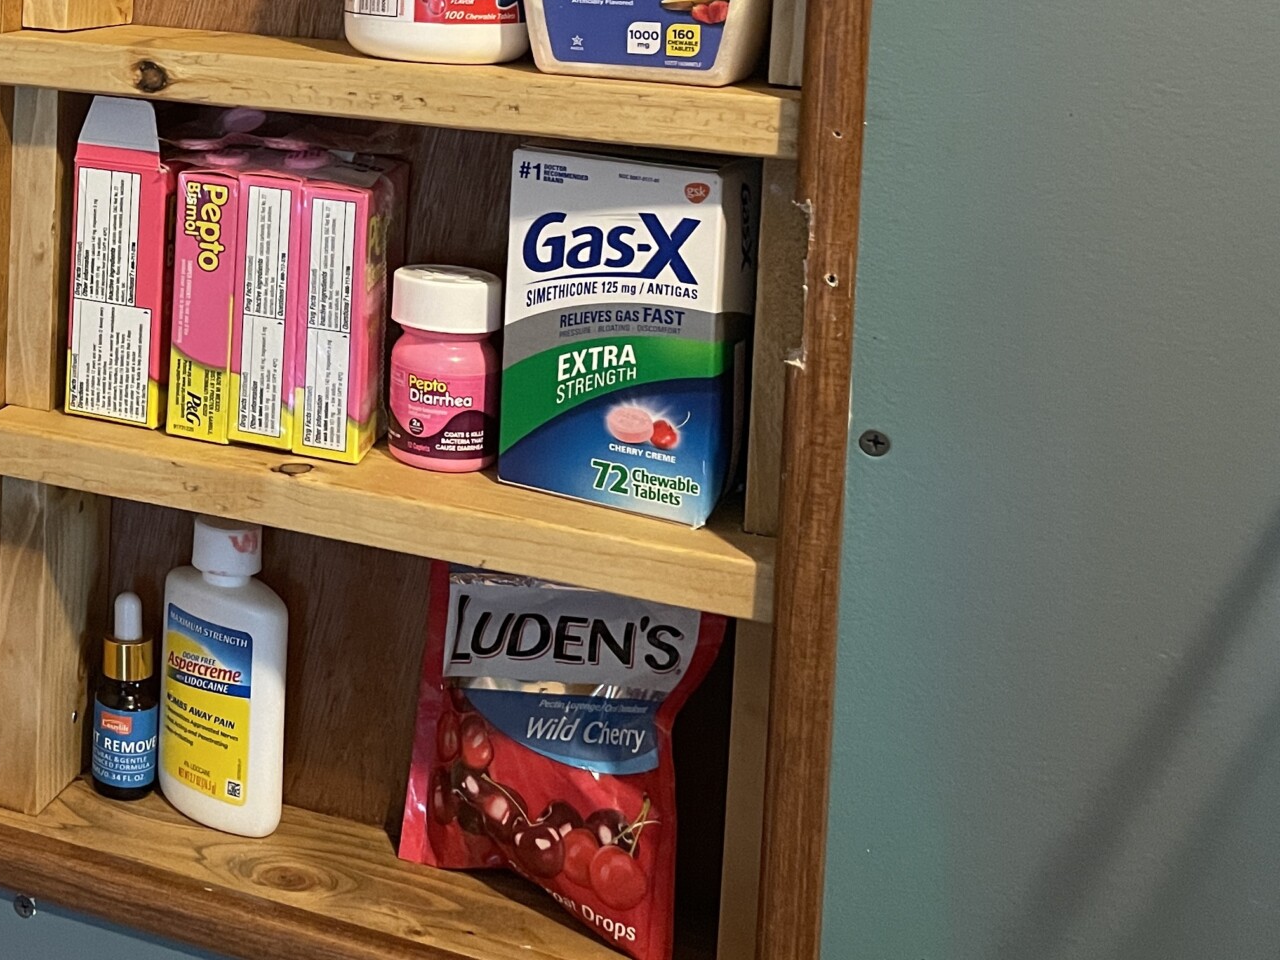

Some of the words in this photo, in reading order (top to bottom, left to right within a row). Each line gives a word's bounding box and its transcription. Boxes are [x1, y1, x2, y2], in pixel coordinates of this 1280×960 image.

[444, 11, 464, 20] 100
[629, 30, 659, 41] 1000
[672, 29, 694, 39] 160
[519, 161, 541, 180] #1
[544, 164, 567, 172] DOCTOR
[544, 171, 589, 181] RECOMMENDED
[543, 176, 564, 184] BRAND
[687, 186, 706, 199] gsk
[184, 181, 201, 236] Bismol
[197, 183, 228, 272] Pepto
[522, 212, 701, 284] Gas-X
[526, 281, 598, 307] SIMETHICONE
[601, 281, 618, 294] 125
[621, 284, 636, 295] mg
[639, 282, 645, 295] /
[646, 283, 698, 299] ANTIGAS
[559, 310, 612, 328] RELIEVES
[615, 310, 639, 322] GAS
[643, 307, 685, 326] FAST
[559, 326, 591, 337] PRESSURE
[598, 324, 630, 332] BLOATING
[637, 324, 681, 334] DISCOMFORT
[557, 344, 636, 381] EXTRA
[409, 374, 447, 393] Pepto
[556, 367, 637, 404] STRENGTH
[409, 388, 473, 407] Diarrhea
[186, 391, 202, 427] P&G
[608, 443, 644, 456] CHERRY
[645, 451, 676, 464] CREME
[591, 458, 630, 495] 72
[632, 468, 700, 496] Chewable
[633, 483, 682, 506] Tablets
[170, 611, 202, 633] MAXIMUM
[203, 628, 248, 648] STRENGTH
[450, 594, 682, 672] LUDEN'S
[168, 650, 242, 683] Aspercreme
[182, 651, 199, 662] ODOR
[201, 657, 216, 666] FREE
[184, 675, 229, 694] LIDOCAINE
[189, 706, 212, 721] AWAY
[214, 716, 235, 729] PAIN
[104, 735, 157, 753] REMOVE
[526, 716, 581, 741] Wild
[583, 721, 646, 753] Cherry
[115, 762, 150, 770] FORMULA
[581, 904, 636, 941] Drops
